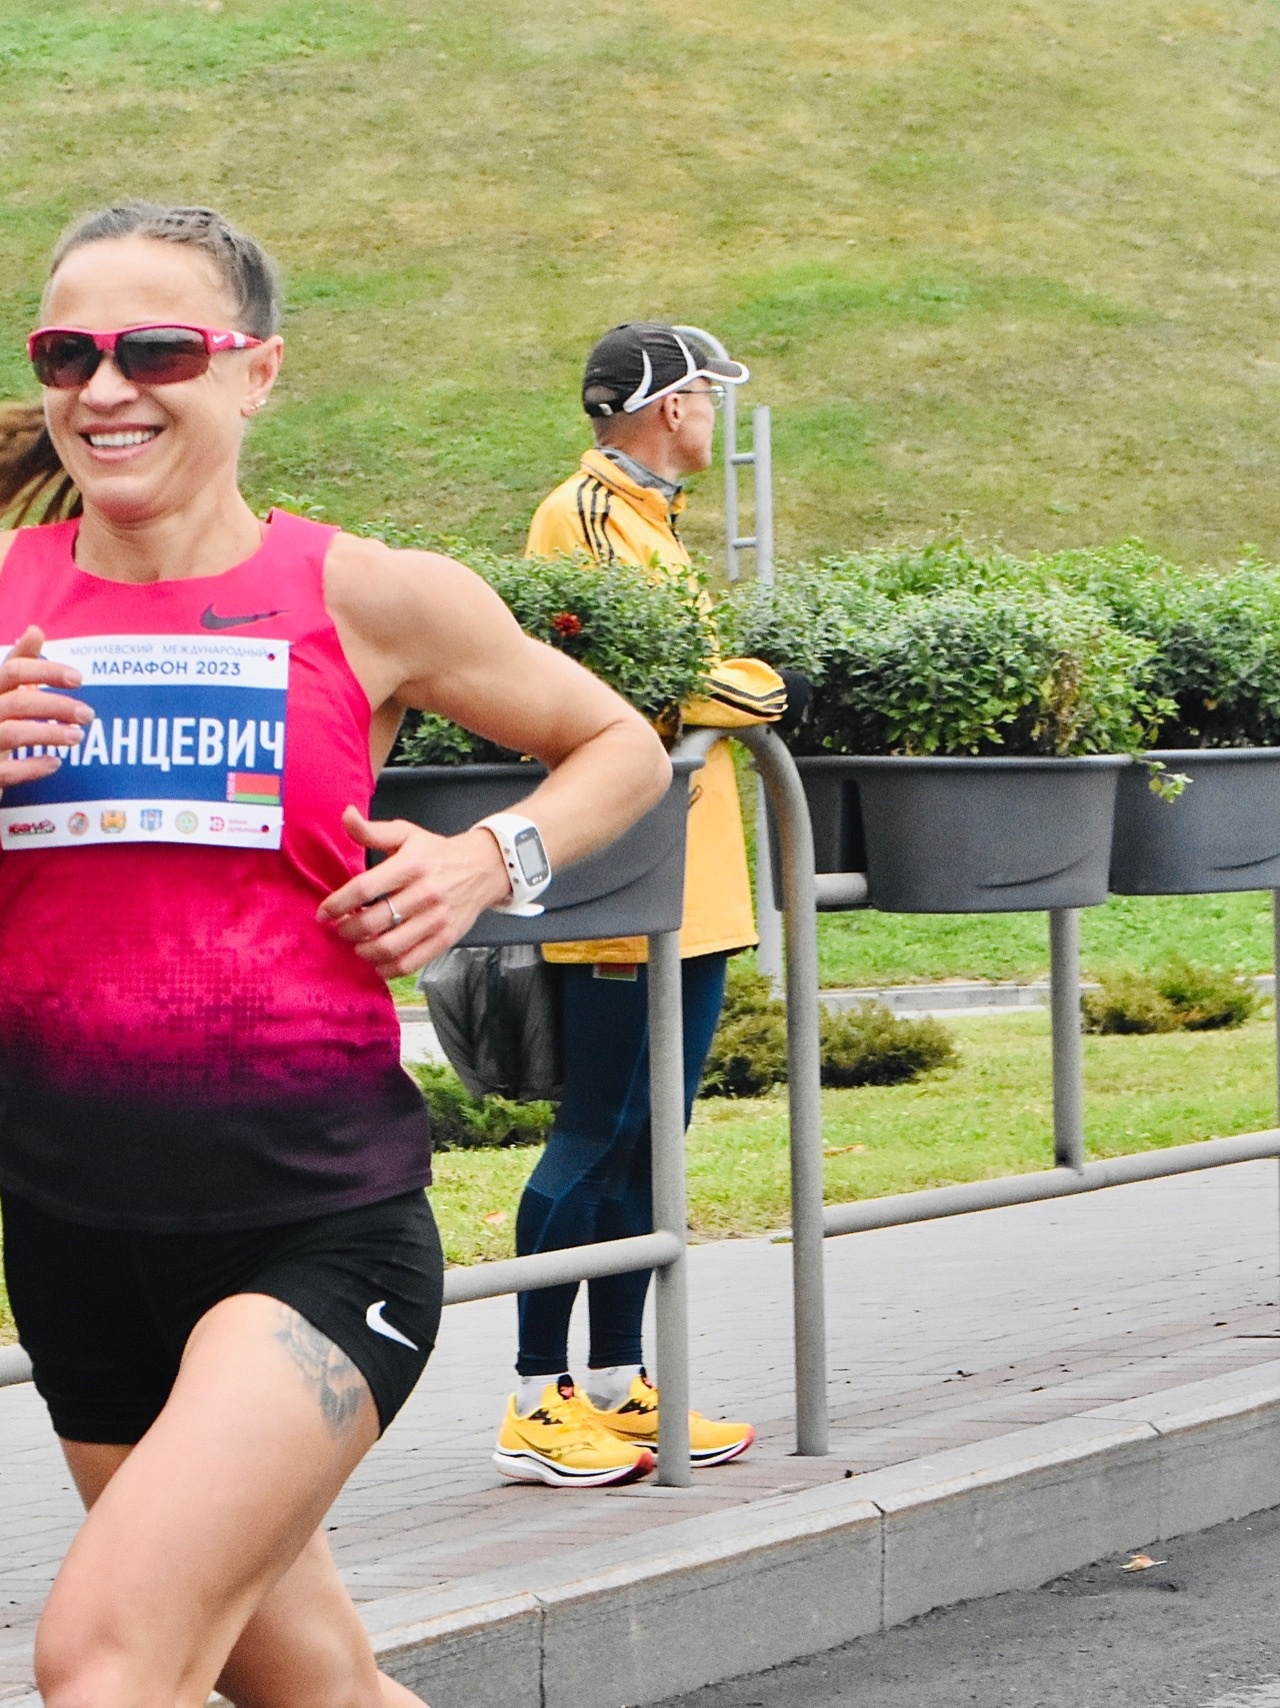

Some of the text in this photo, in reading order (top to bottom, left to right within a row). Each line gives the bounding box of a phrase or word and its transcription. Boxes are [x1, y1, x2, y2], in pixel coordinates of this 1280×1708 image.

[161, 643, 267, 658] МЕЖДУНАРОДНЫЙ
[92, 660, 241, 677] МАРАФОН 2023
[9, 717, 285, 773] АНЦЕВИЧ
